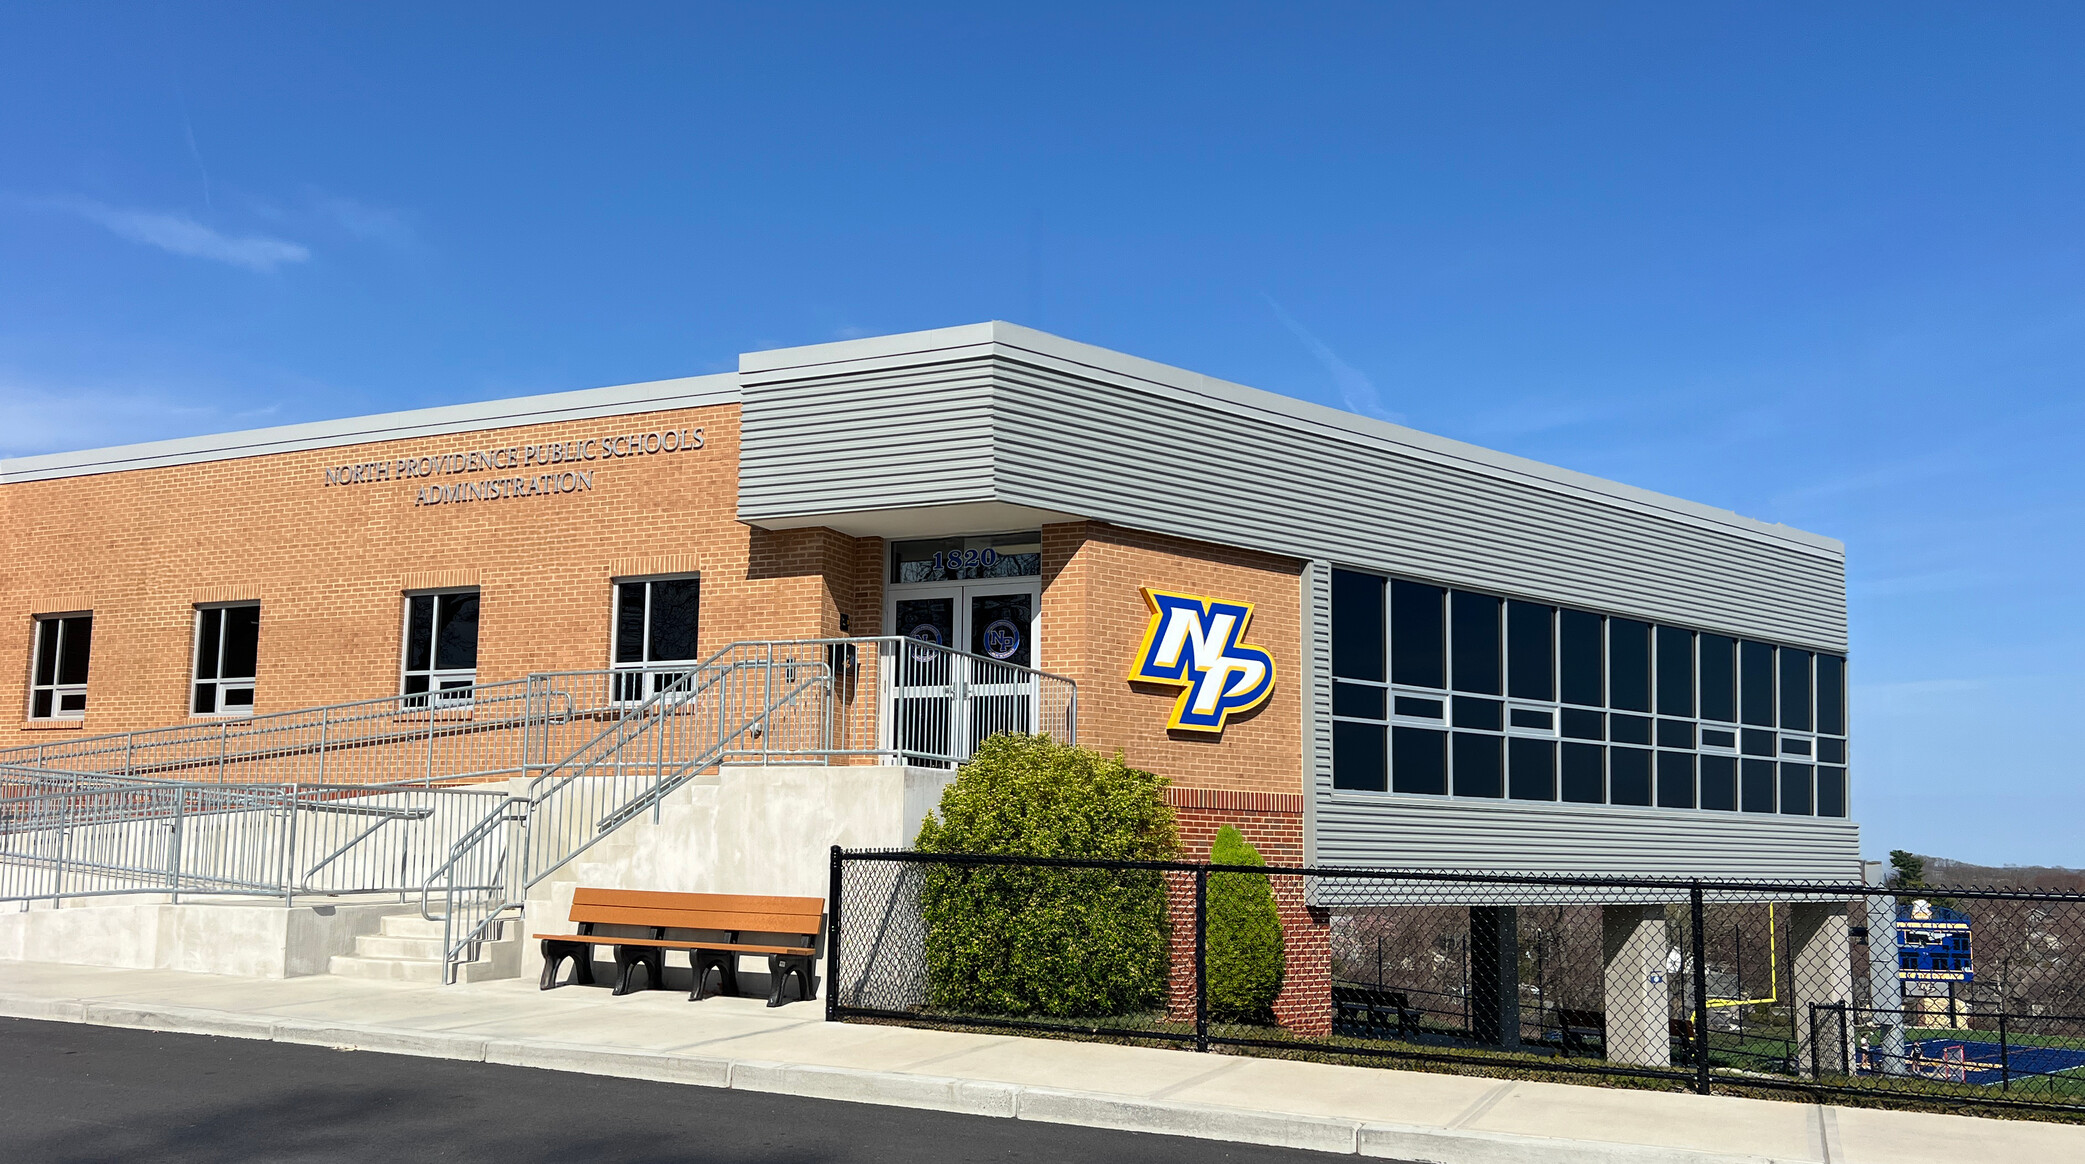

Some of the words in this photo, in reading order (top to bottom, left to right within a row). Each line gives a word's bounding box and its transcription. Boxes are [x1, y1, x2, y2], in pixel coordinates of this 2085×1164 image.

[325, 460, 390, 487] NORTH
[396, 446, 519, 479] PROVIDENCE
[524, 439, 597, 467] PUBLIC
[602, 427, 705, 459] SCHOOLS
[414, 470, 595, 507] ADMINISTRATION
[933, 548, 997, 570] 1820
[990, 629, 1014, 652] NP
[1140, 592, 1273, 728] NP
